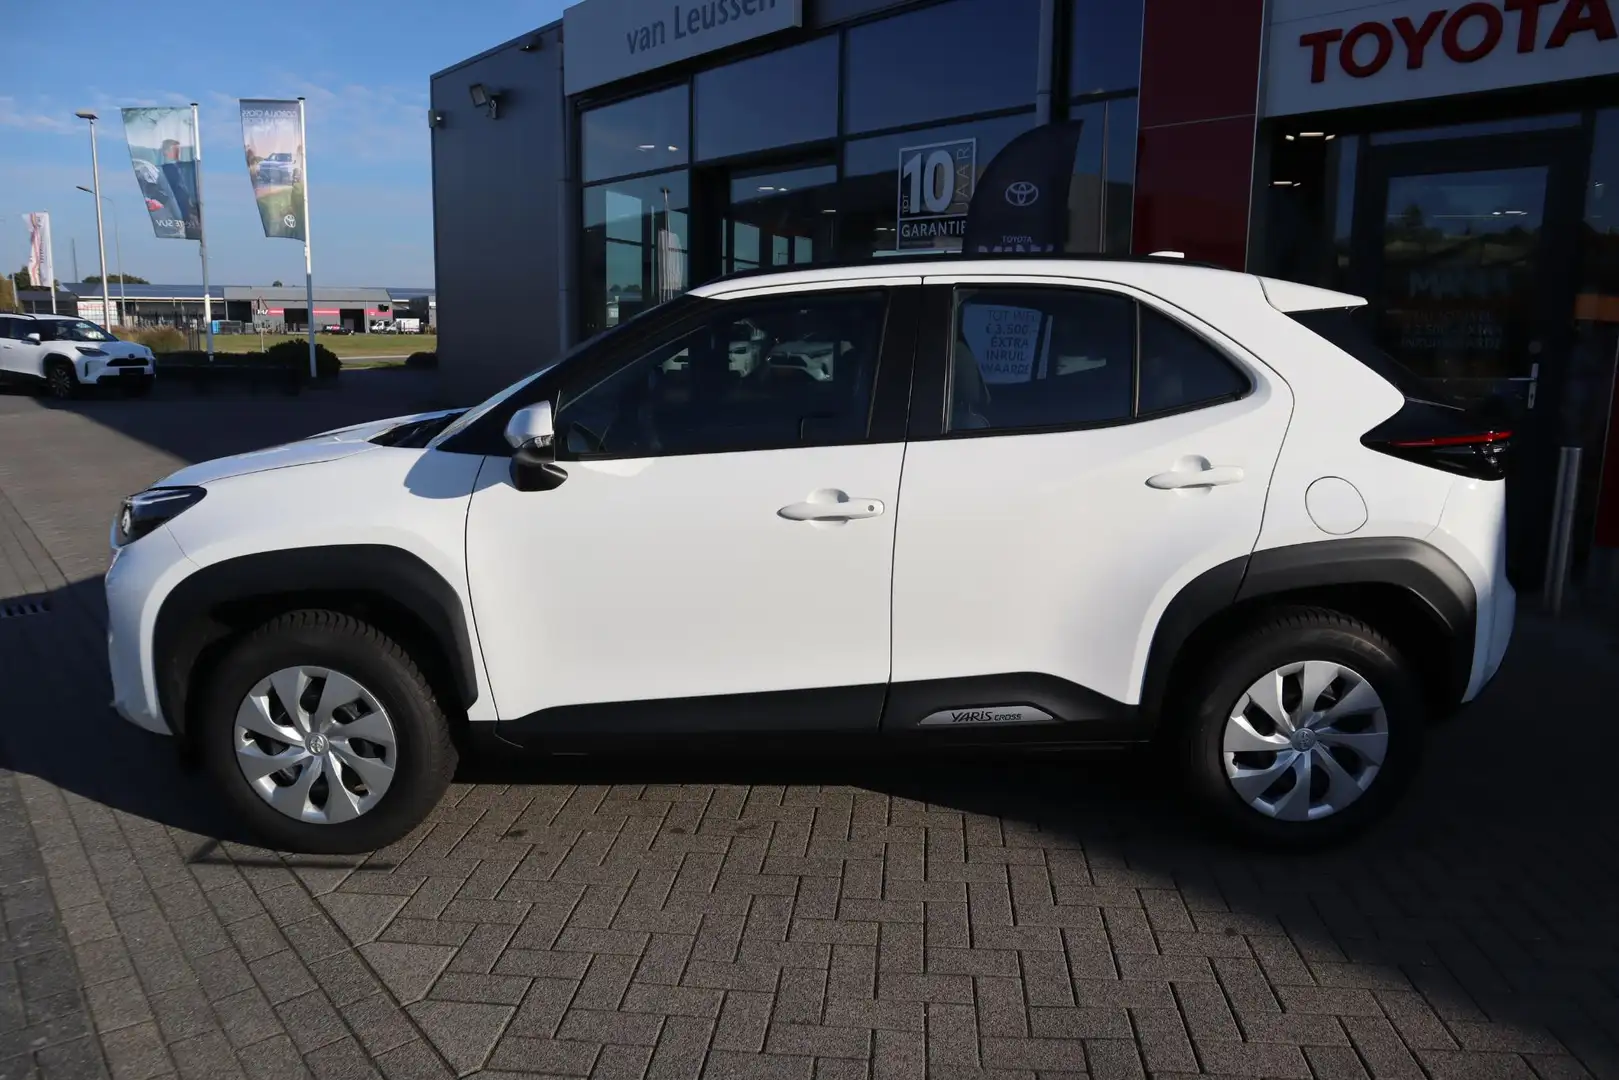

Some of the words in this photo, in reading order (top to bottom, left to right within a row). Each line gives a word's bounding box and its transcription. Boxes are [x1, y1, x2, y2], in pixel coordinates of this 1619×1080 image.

[626, 20, 665, 54] van
[674, 0, 775, 39] Leussen
[1300, 0, 1618, 84] TOYOTA
[903, 150, 954, 214] 10
[955, 146, 970, 210] JAAR
[902, 194, 910, 214] TOT
[1002, 235, 1032, 244] TOYOTA
[991, 336, 1029, 348] EXTRA
[951, 711, 993, 722] YARIS
[994, 713, 1022, 721] CROSS
